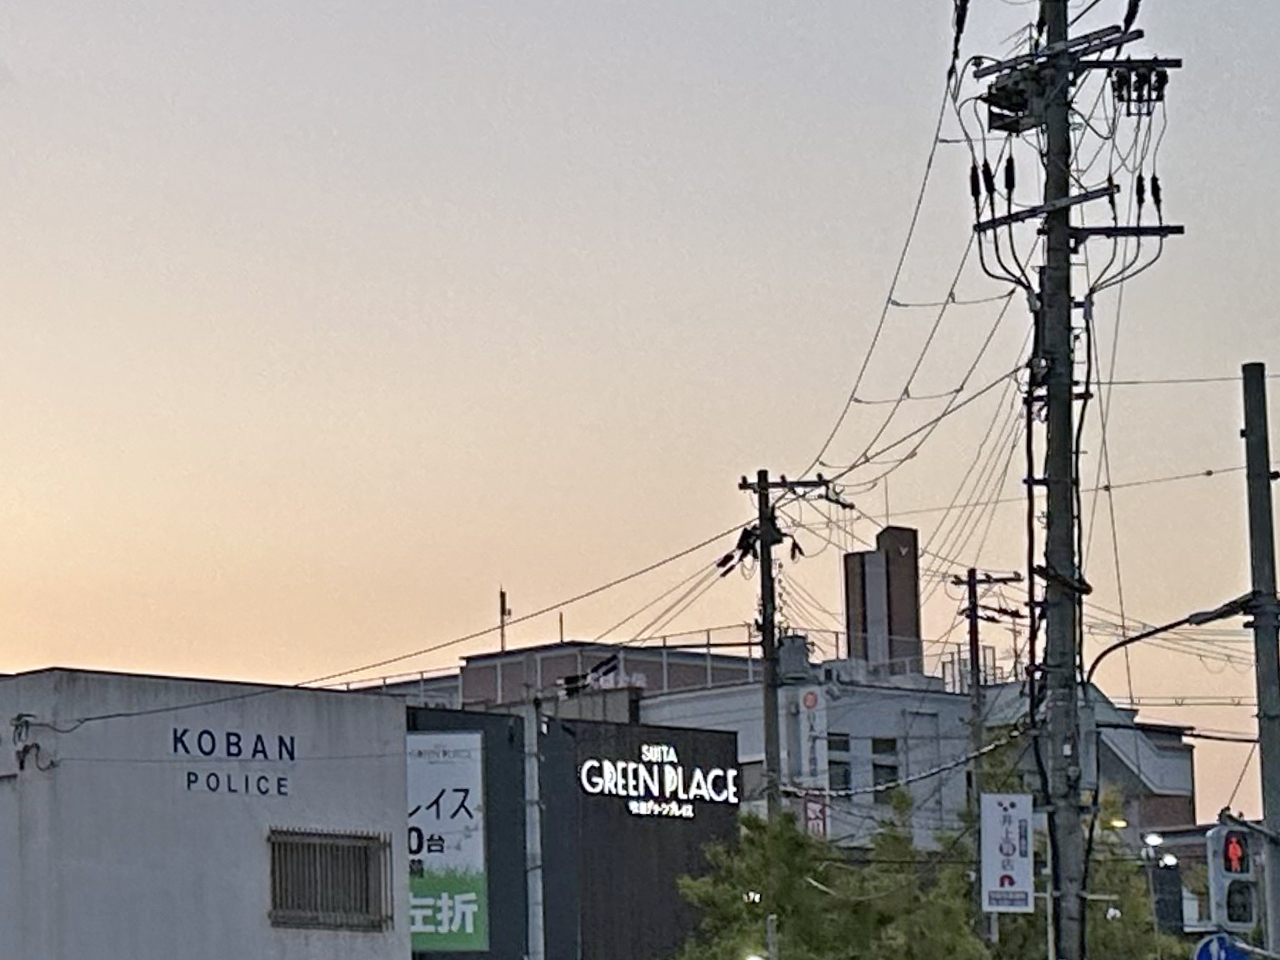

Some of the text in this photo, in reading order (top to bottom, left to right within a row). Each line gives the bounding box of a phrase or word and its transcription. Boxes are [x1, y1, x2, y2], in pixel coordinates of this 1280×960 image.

[172, 727, 296, 761] KOBAN
[641, 744, 678, 763] SUITA
[186, 771, 289, 796] POLICE
[580, 758, 739, 804] GREEN PLACE
